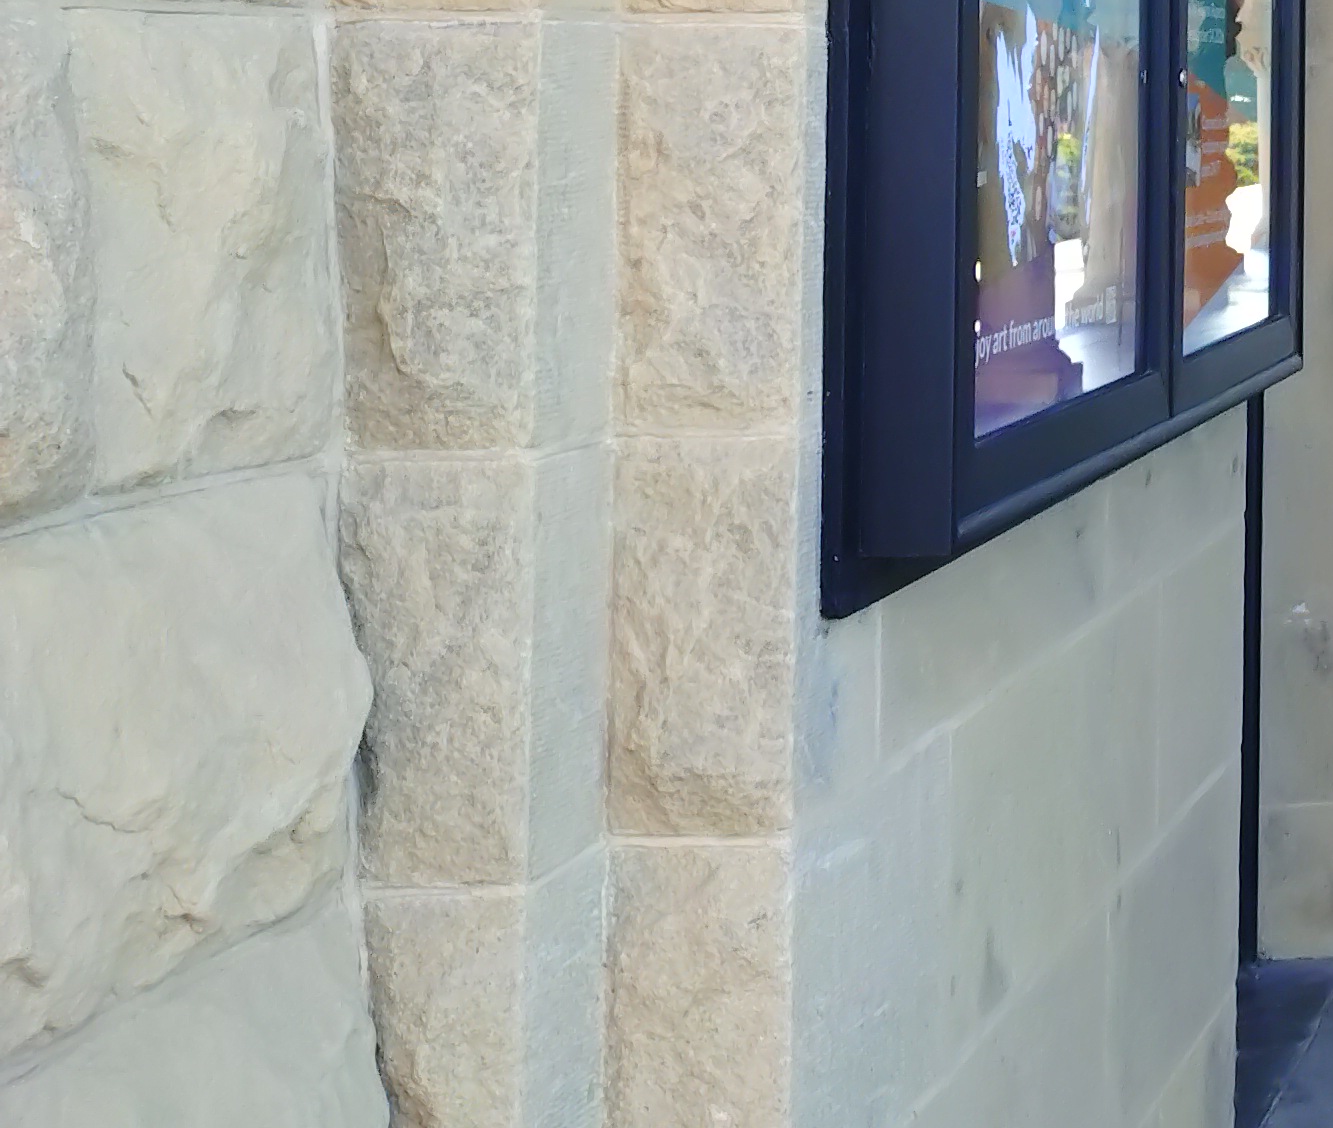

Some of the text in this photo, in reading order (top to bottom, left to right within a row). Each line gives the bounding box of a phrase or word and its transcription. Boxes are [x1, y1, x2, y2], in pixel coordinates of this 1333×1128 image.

[992, 326, 1008, 355] art
[1009, 320, 1032, 349] from
[1033, 316, 1056, 340] arou
